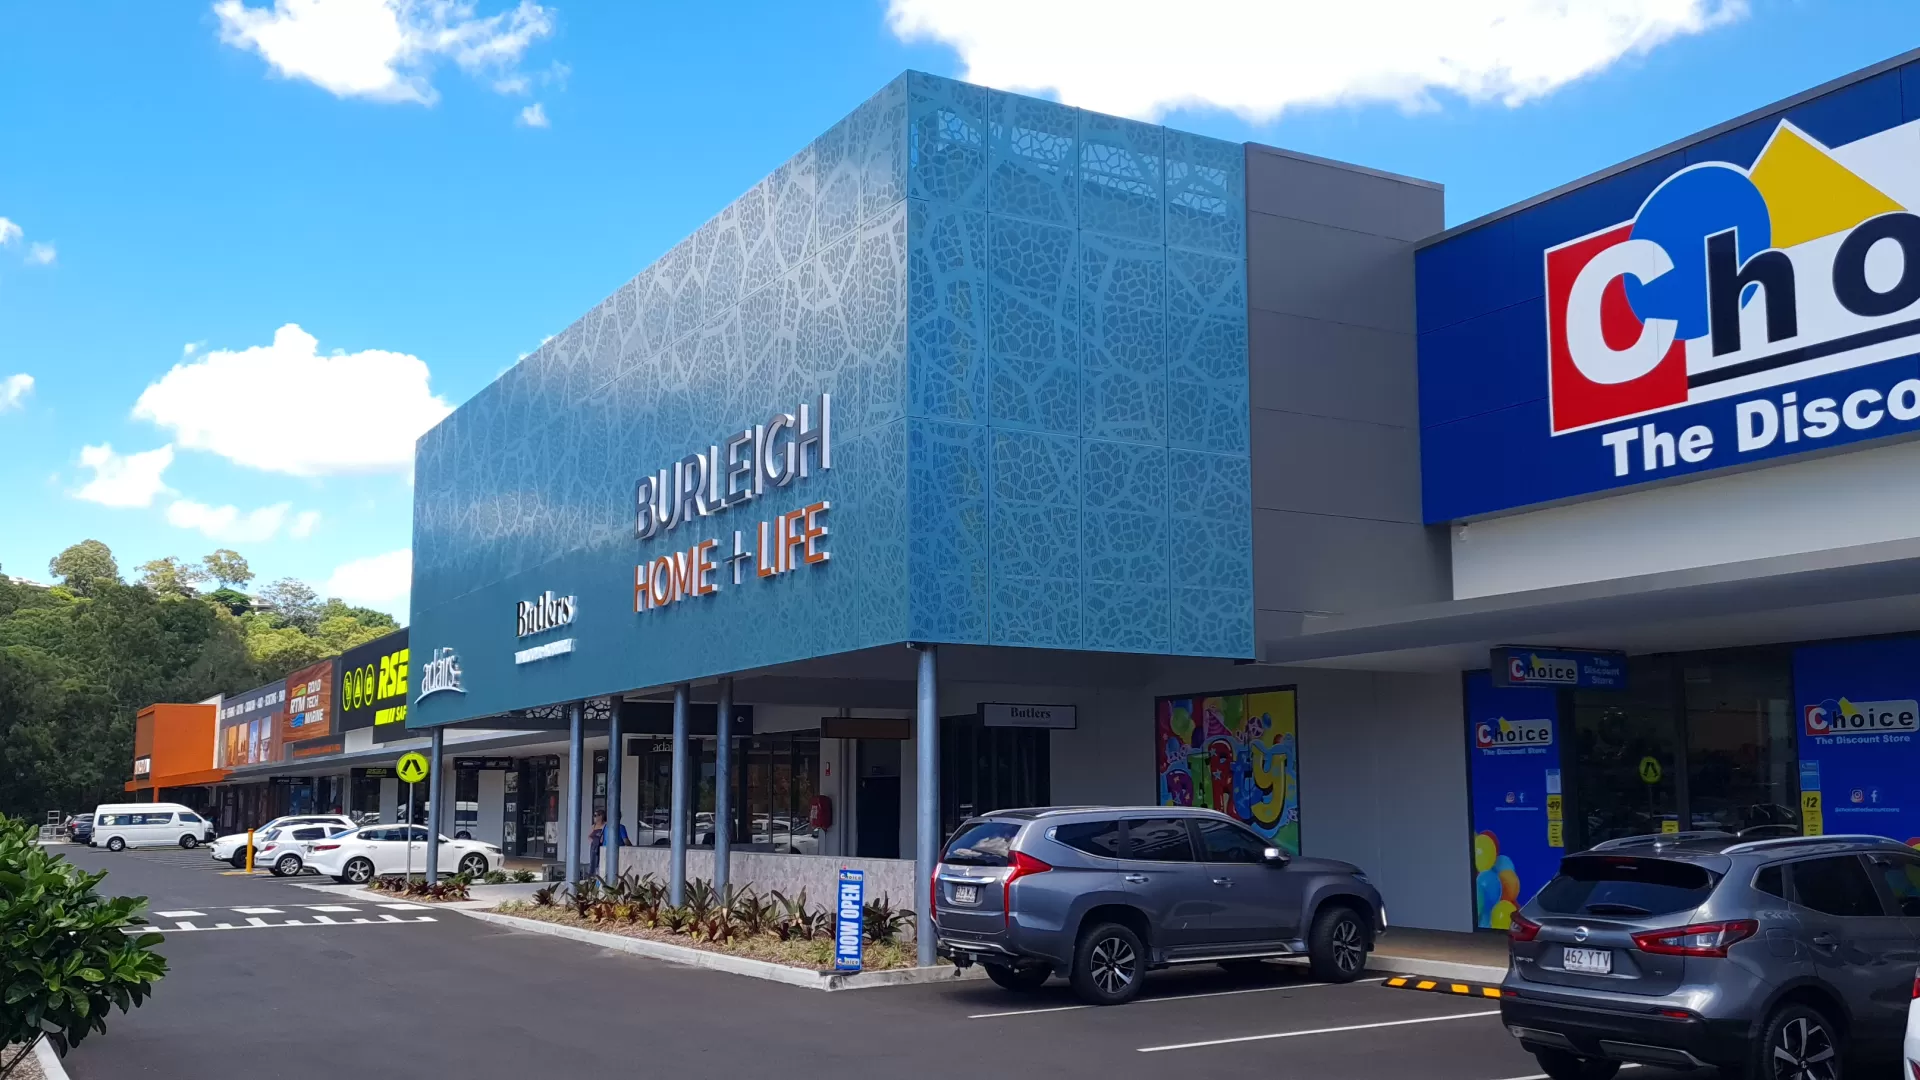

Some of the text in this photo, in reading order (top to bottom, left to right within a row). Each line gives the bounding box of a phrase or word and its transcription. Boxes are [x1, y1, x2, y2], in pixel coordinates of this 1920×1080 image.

[1602, 423, 1714, 477] The
[634, 393, 830, 540] BURLEIGH
[634, 501, 830, 612] HOME + LIFE
[516, 590, 577, 637] Butlers
[1511, 658, 1576, 679] Choice
[1593, 656, 1609, 667] The
[377, 648, 408, 700] RSE
[1584, 666, 1620, 676] Discount
[1591, 676, 1614, 684] Store
[308, 679, 321, 694] ROAD
[290, 696, 305, 714] RTM
[306, 695, 319, 708] TECH
[304, 708, 324, 724] MARINE
[1010, 706, 1051, 719] Butlers
[1808, 706, 1914, 730] Choice
[1478, 724, 1549, 744] Choice
[1815, 734, 1911, 745] The Discount Store
[839, 884, 860, 955] NOW OPEN
[1565, 949, 1610, 967] 462 YTV
